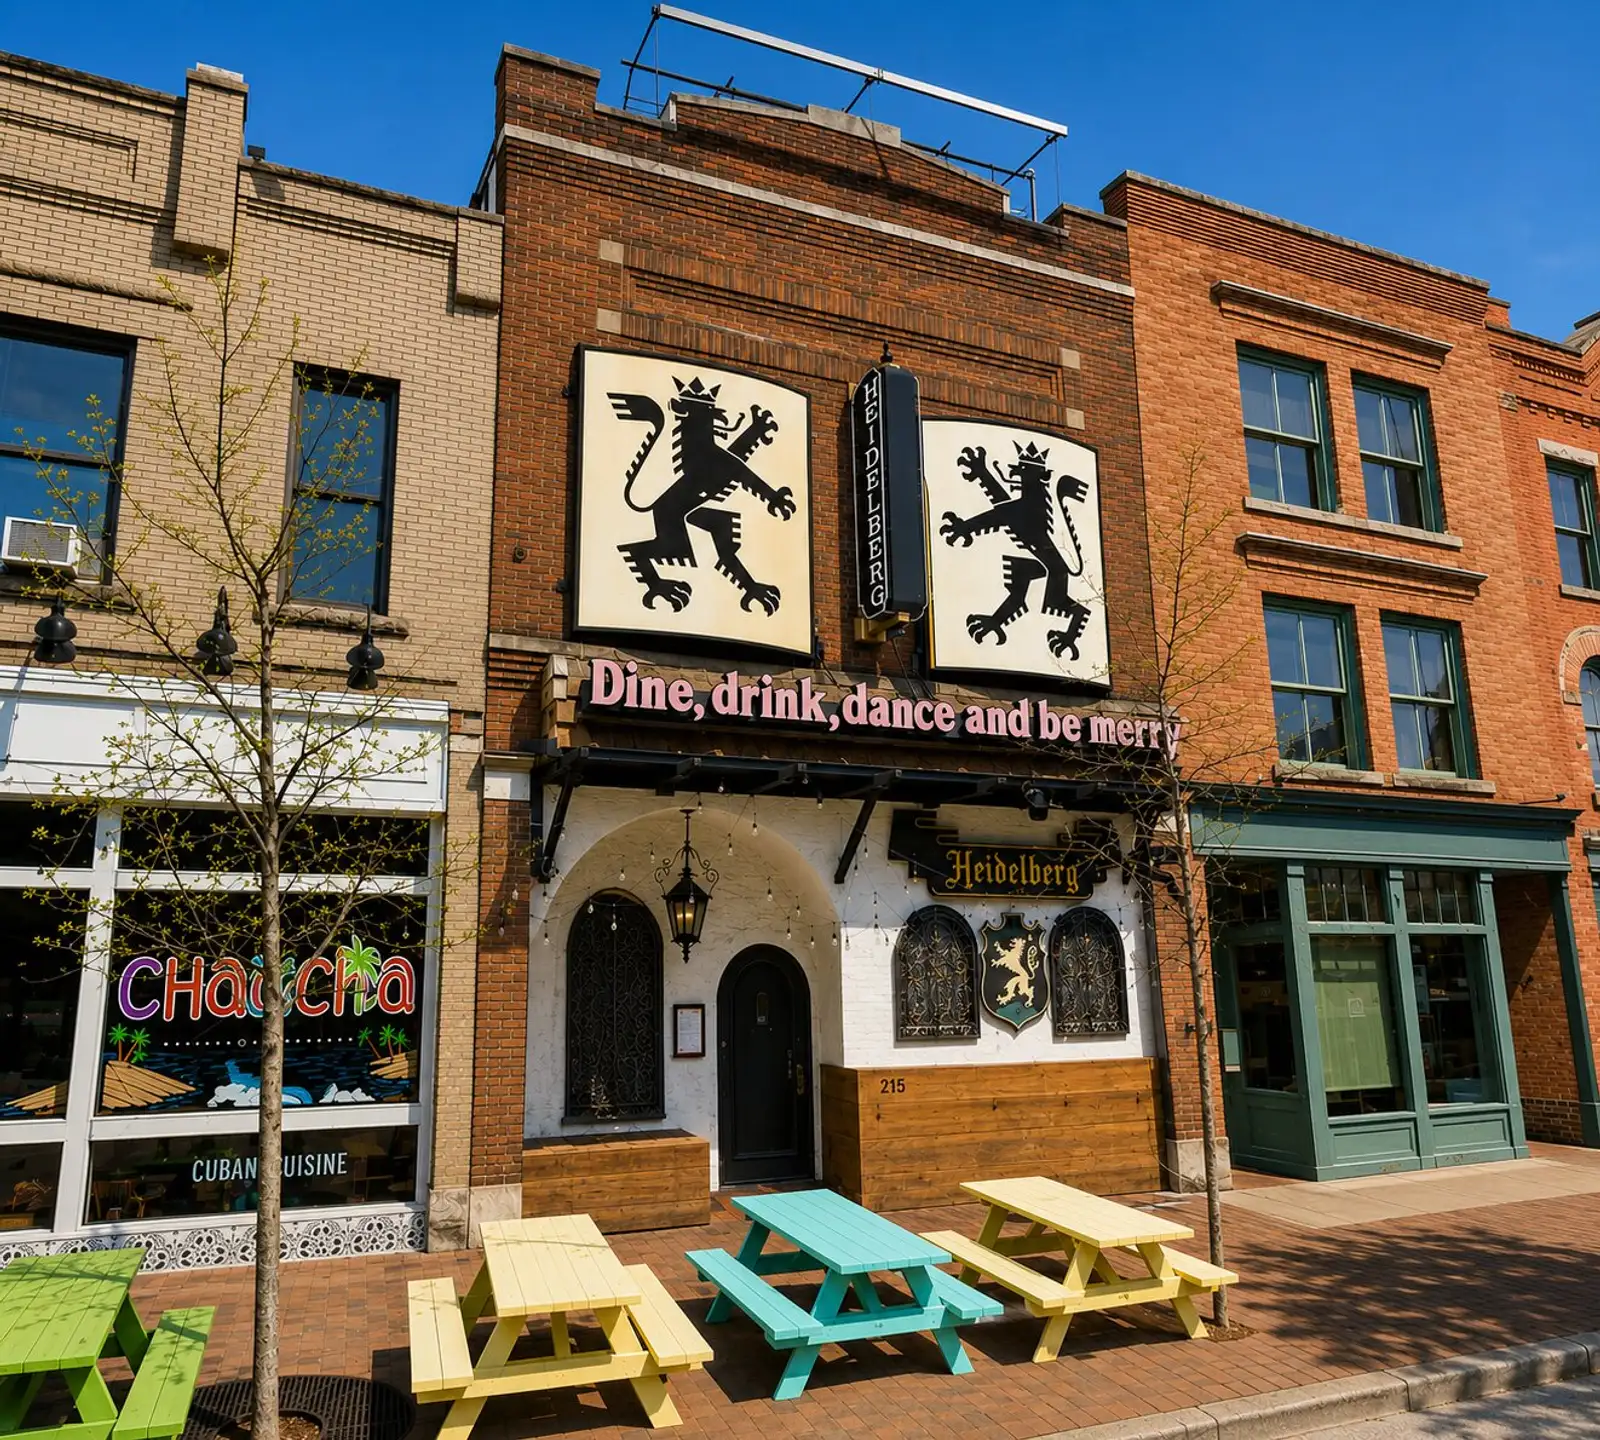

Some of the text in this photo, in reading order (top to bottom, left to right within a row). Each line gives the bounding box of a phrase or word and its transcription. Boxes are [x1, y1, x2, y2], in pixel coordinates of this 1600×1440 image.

[863, 375, 885, 608] HEIDELBERG
[589, 657, 1182, 762] Dine, drink, dance and be merry
[945, 848, 1080, 894] Heidelberg
[879, 1078, 906, 1094] 215
[191, 1151, 349, 1183] CUBAN UISINE
